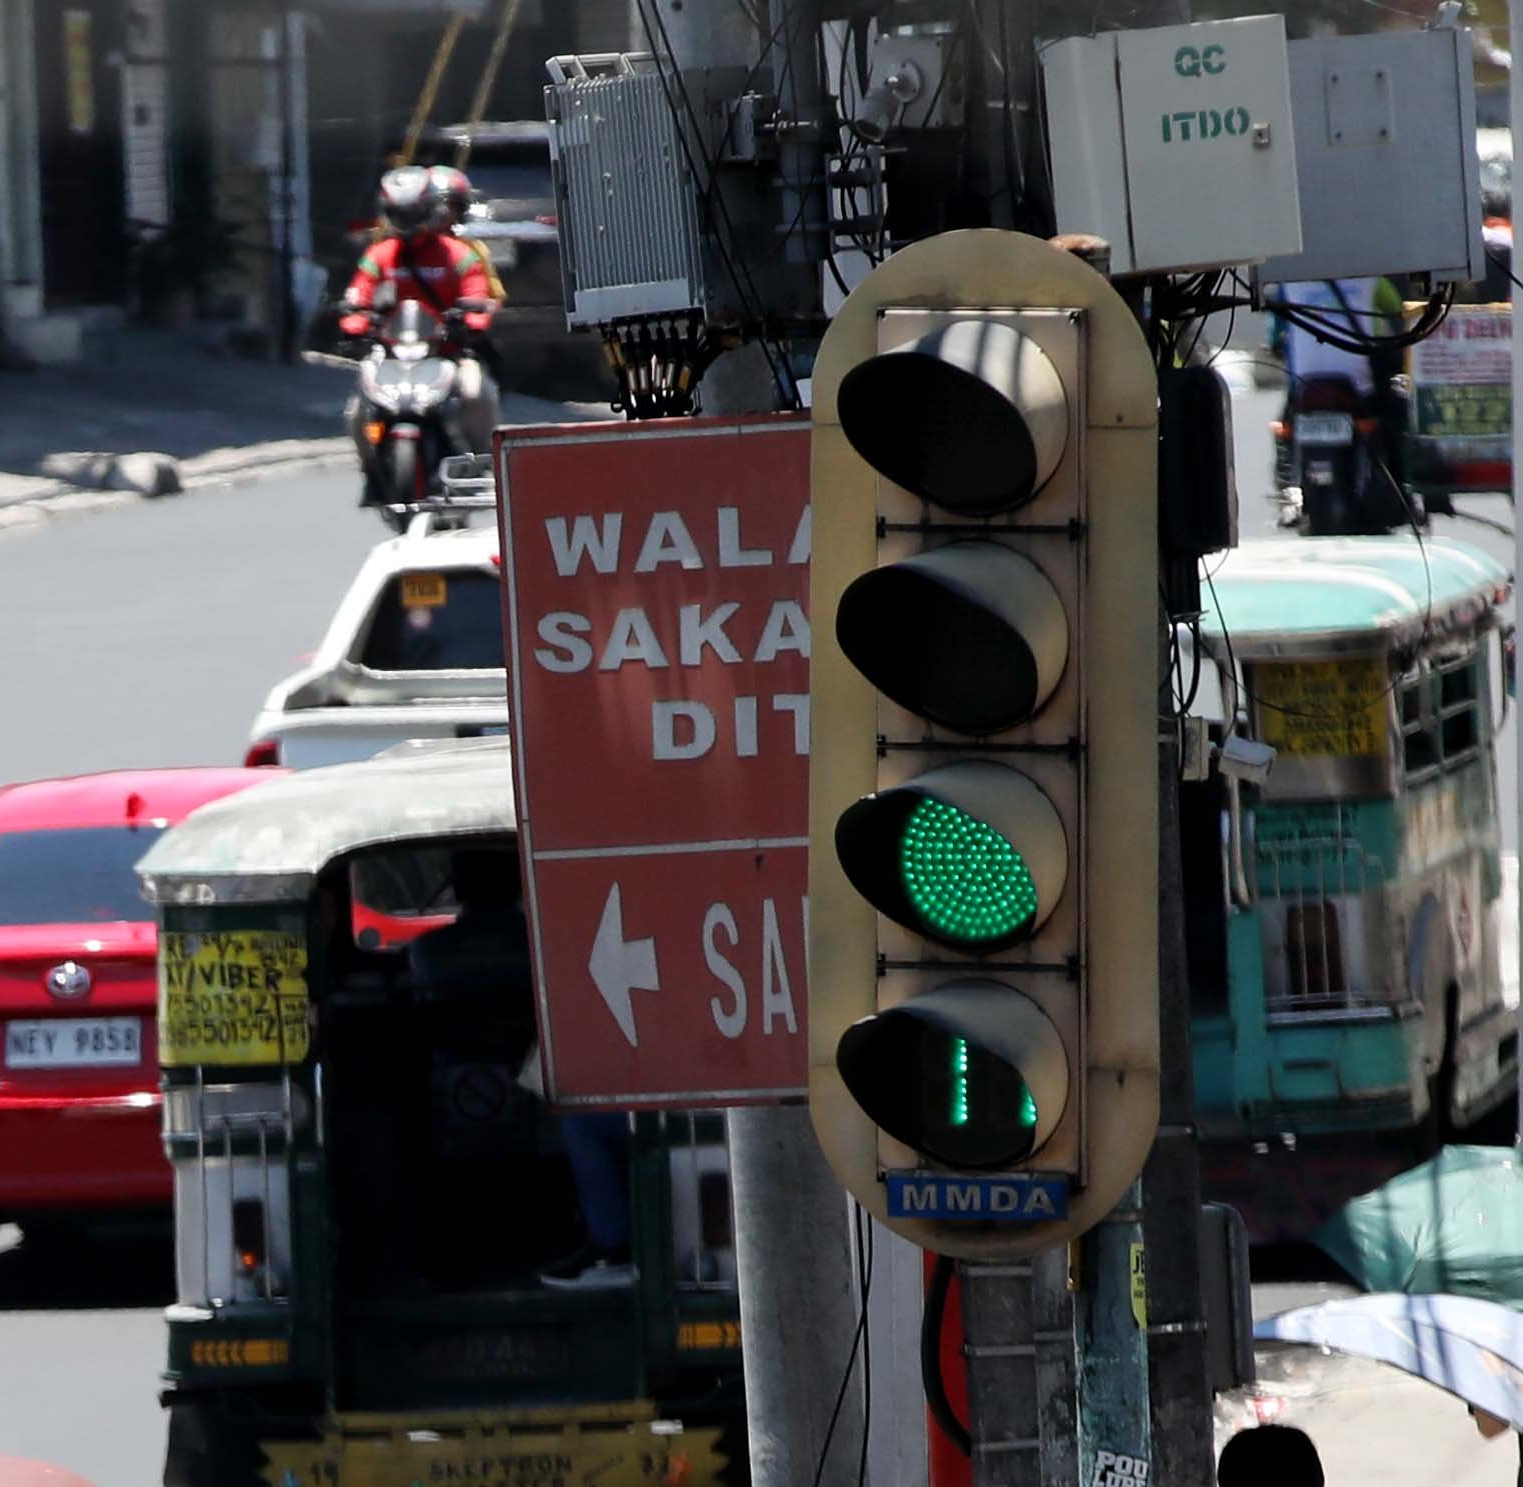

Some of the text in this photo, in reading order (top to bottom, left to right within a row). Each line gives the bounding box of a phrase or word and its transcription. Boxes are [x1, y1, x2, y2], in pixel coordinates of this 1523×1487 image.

[1174, 44, 1226, 78] QC
[1161, 107, 1250, 143] ITDO
[702, 896, 810, 1039] SA
[902, 1183, 1056, 1215] MMDA
